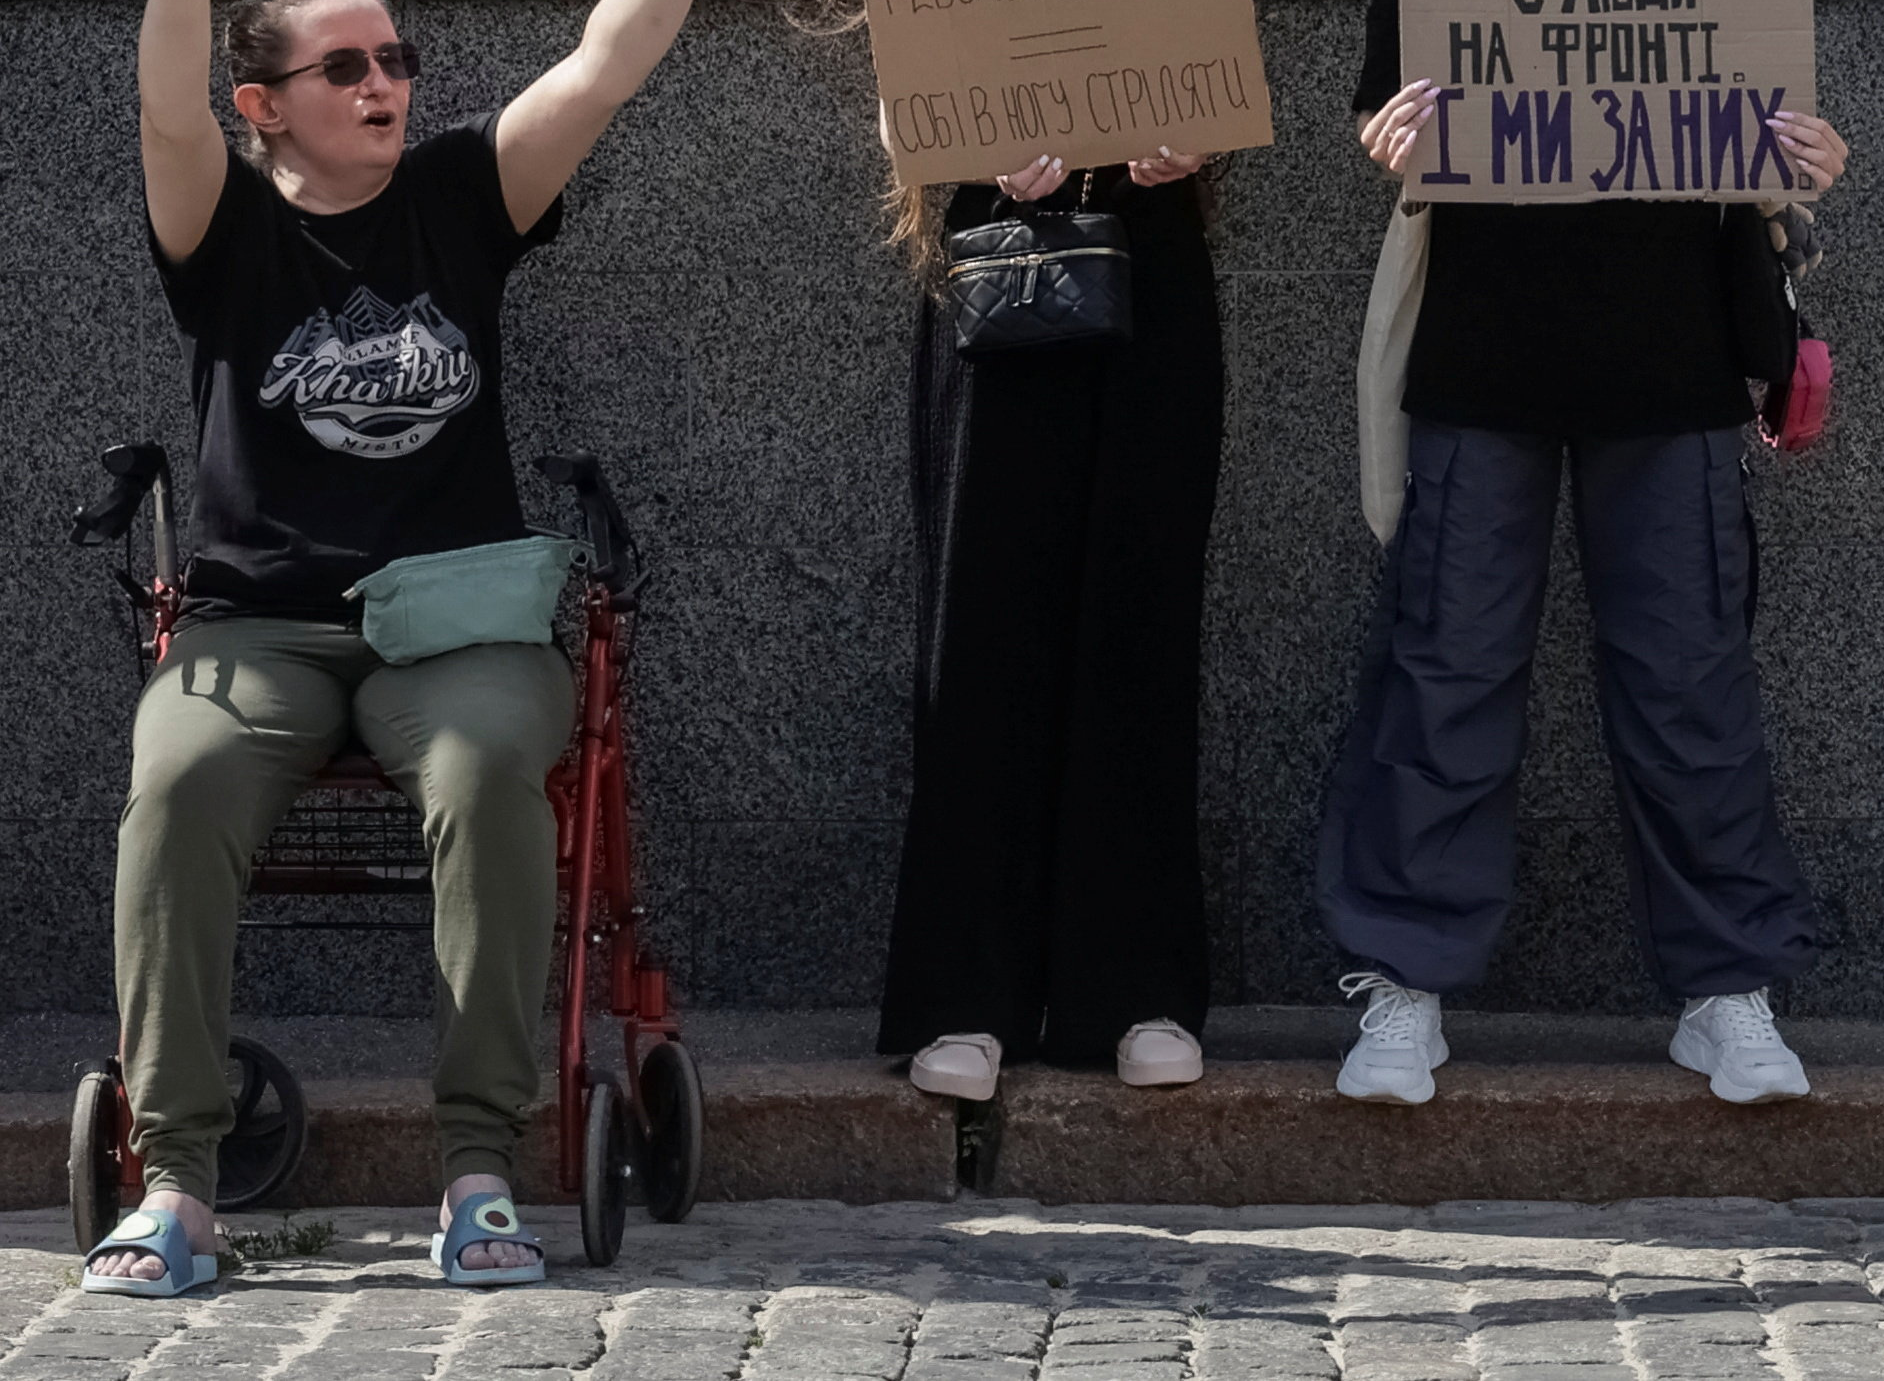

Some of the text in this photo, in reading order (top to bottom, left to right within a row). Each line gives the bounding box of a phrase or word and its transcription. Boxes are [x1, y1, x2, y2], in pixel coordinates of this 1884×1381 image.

[1448, 21, 1514, 86] НА
[892, 57, 1251, 154] СОБІ В НОГУ СТРІЛЯТИ
[1420, 88, 1471, 185] І
[1490, 89, 1573, 185] МИ
[1589, 89, 1661, 192] ЗА
[259, 345, 471, 407] Kharkiv
[340, 432, 421, 452] MISTO
